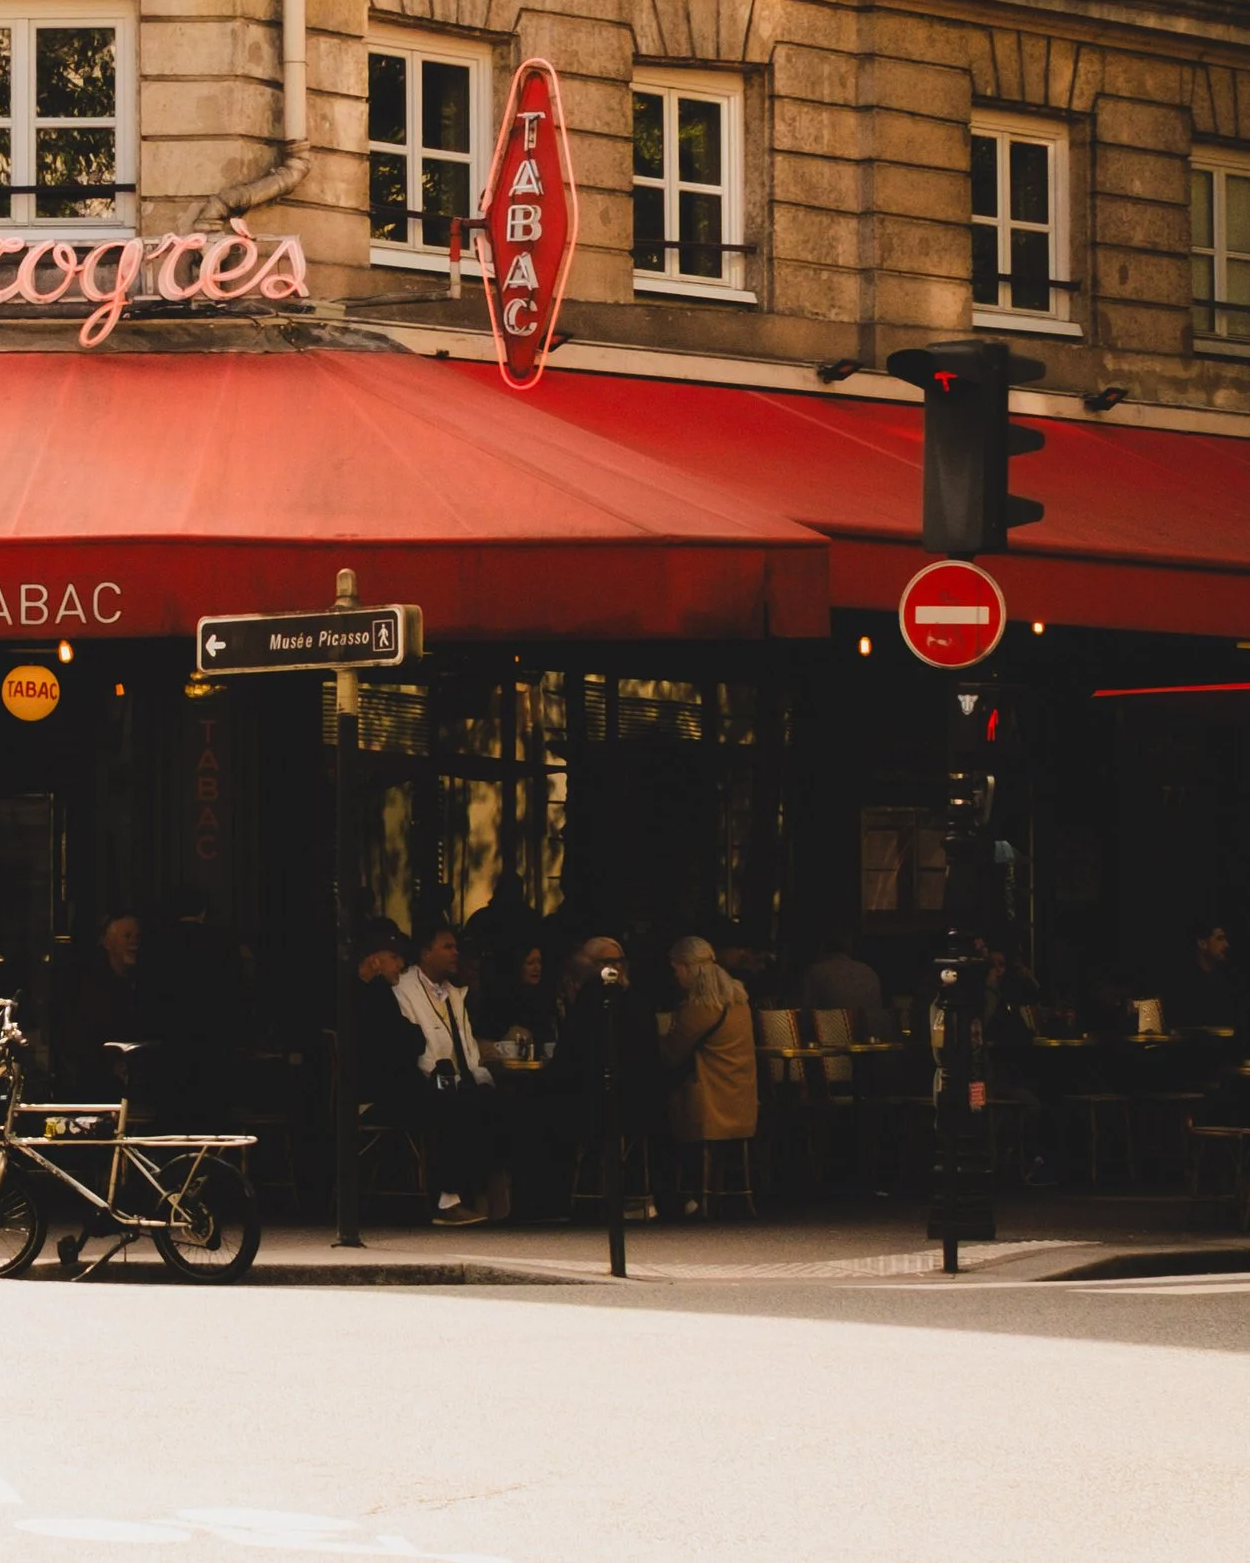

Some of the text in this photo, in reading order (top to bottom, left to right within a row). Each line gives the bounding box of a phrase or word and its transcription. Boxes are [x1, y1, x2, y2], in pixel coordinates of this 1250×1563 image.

[504, 111, 546, 337] TABAC
[269, 629, 371, 651] Musée Picasso
[6, 678, 59, 701] TABAC
[196, 718, 220, 860] TABAC
